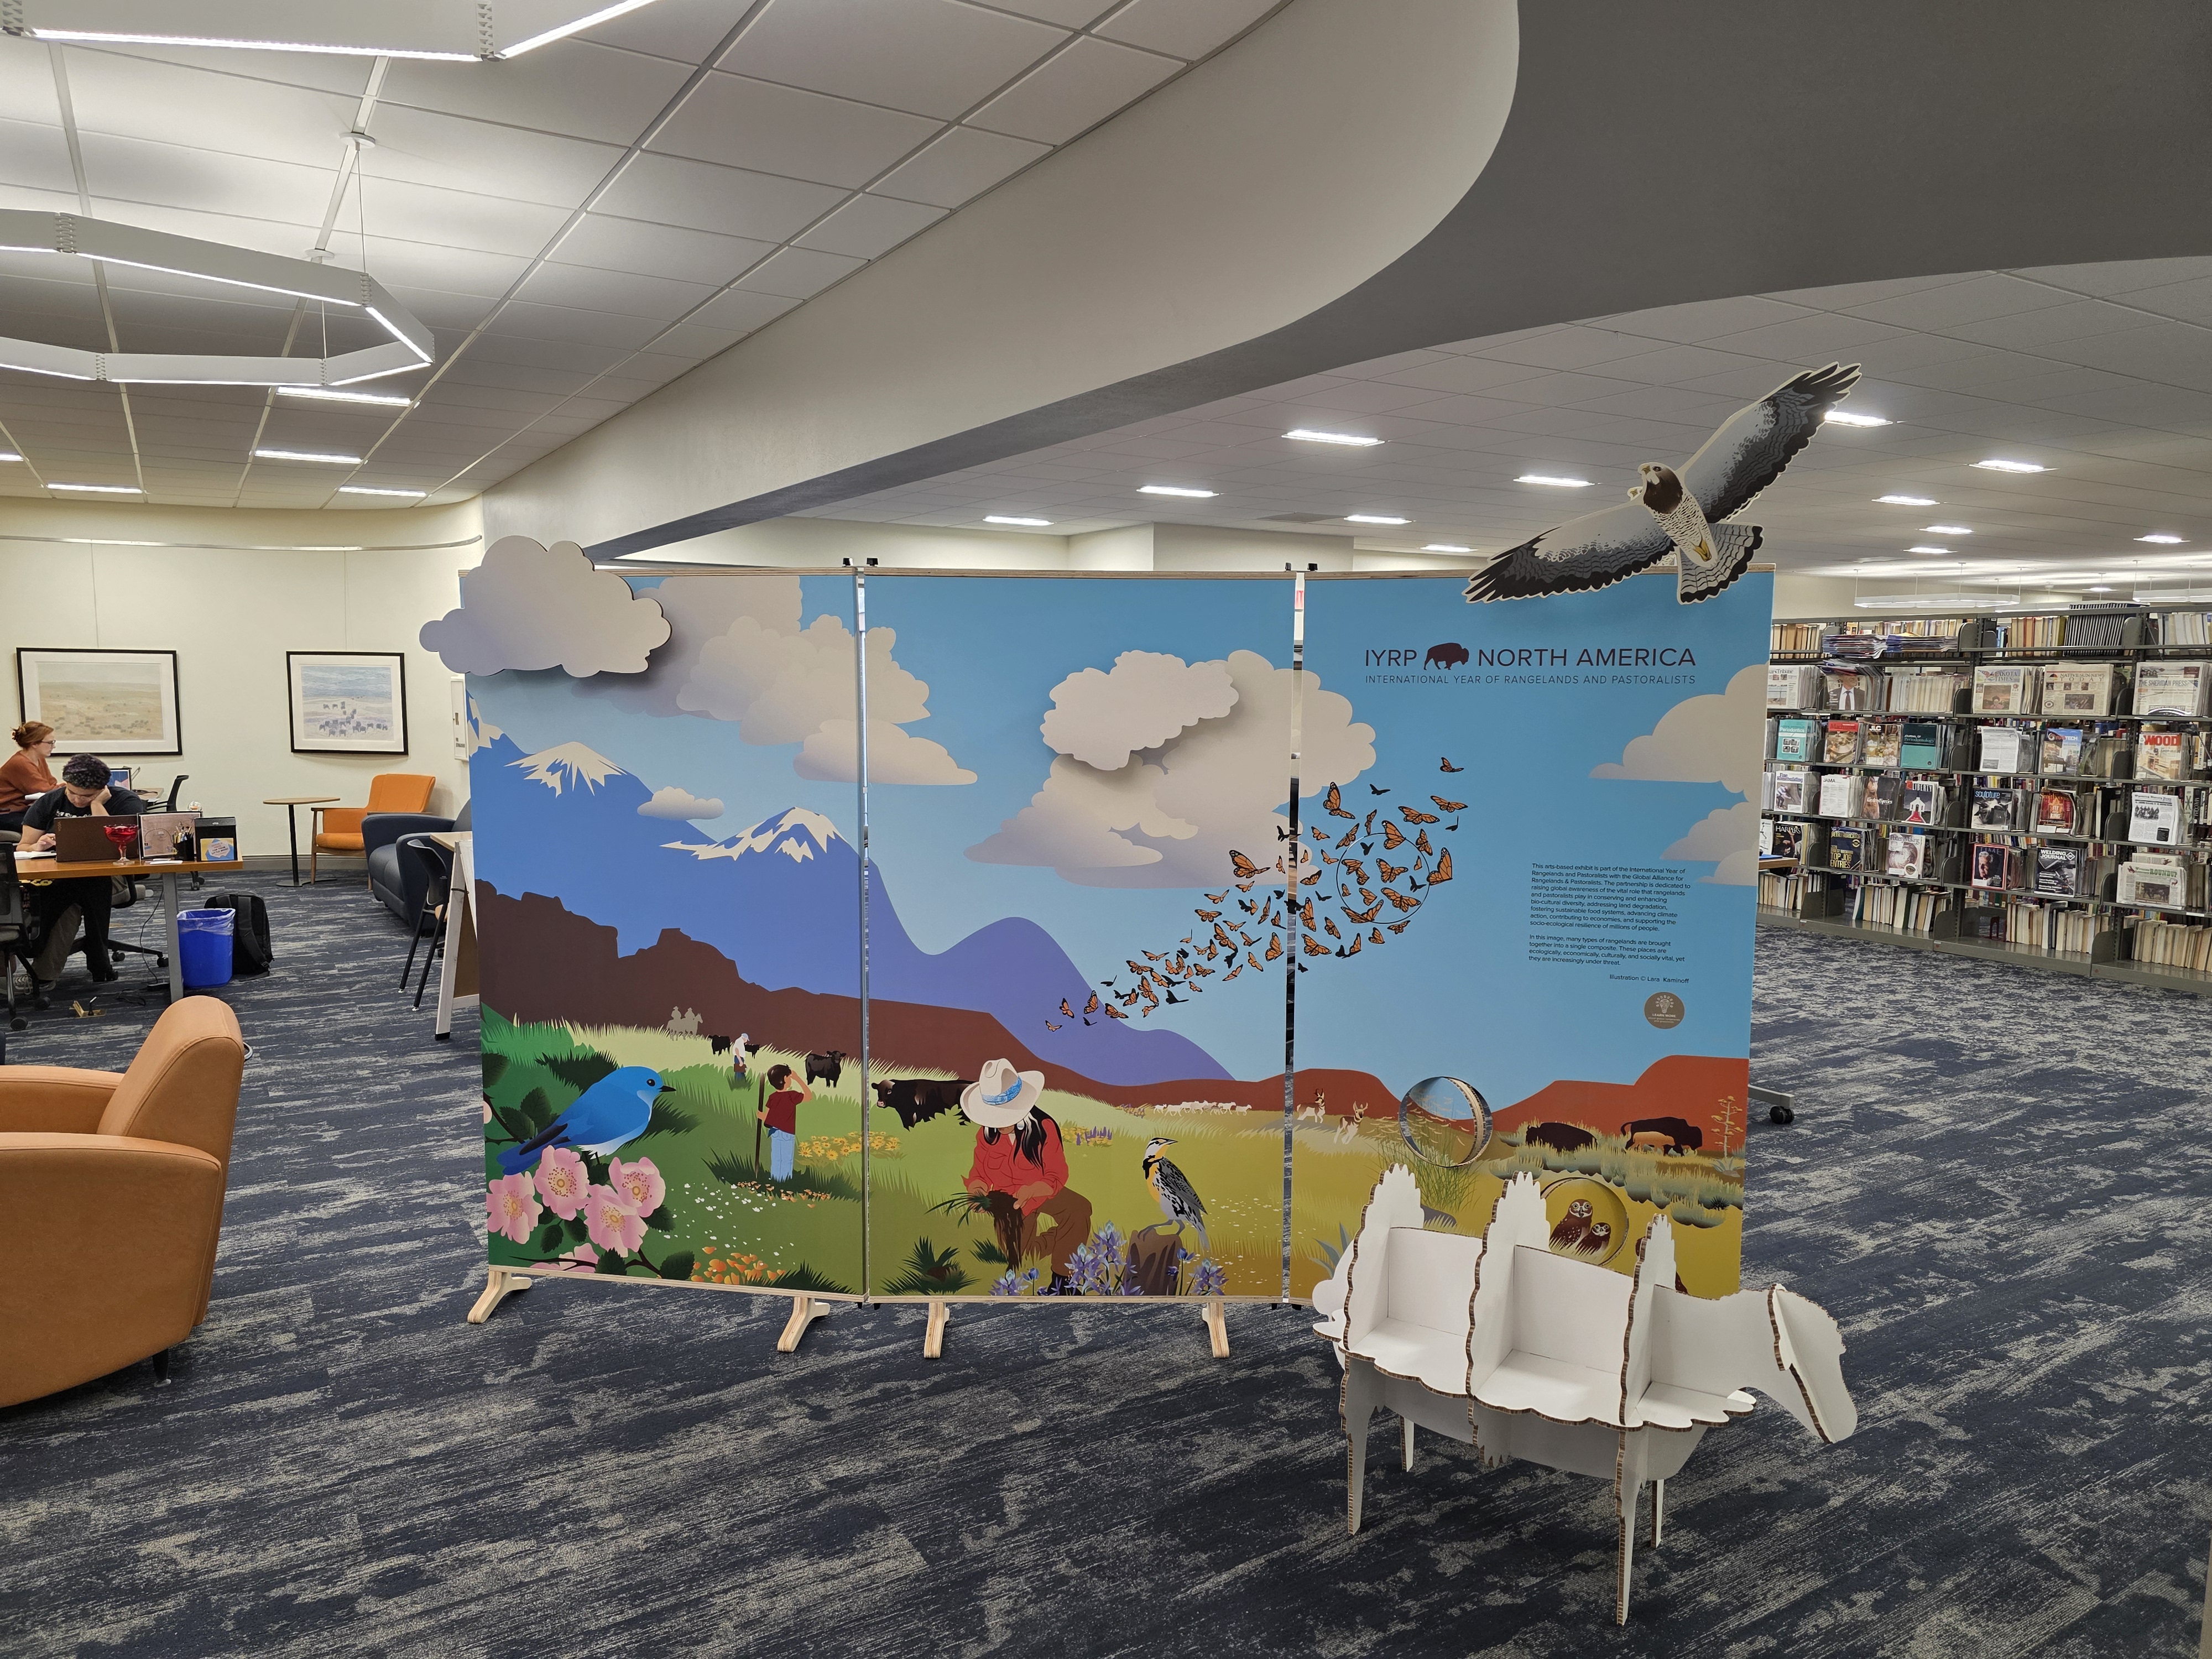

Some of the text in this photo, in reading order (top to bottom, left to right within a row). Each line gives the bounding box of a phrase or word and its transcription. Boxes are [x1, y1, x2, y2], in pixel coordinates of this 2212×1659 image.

[1365, 648, 1696, 666] IYRP NORTH AMERICA
[1365, 675, 1695, 684] INTERNATIONAL YEAR OF RANGELANDS AND PASTORALISTS
[2143, 735, 2181, 746] WOOD
[1912, 783, 1932, 792] LIBERTY
[1975, 790, 2000, 799] sculpture
[1980, 847, 2002, 856] TIME
[1830, 859, 1850, 869] ENTRIES
[2150, 868, 2178, 878] ROUNDUP
[1531, 905, 1554, 914] fostering
[1587, 901, 1617, 909] addressing
[1552, 956, 1584, 964] increasingly
